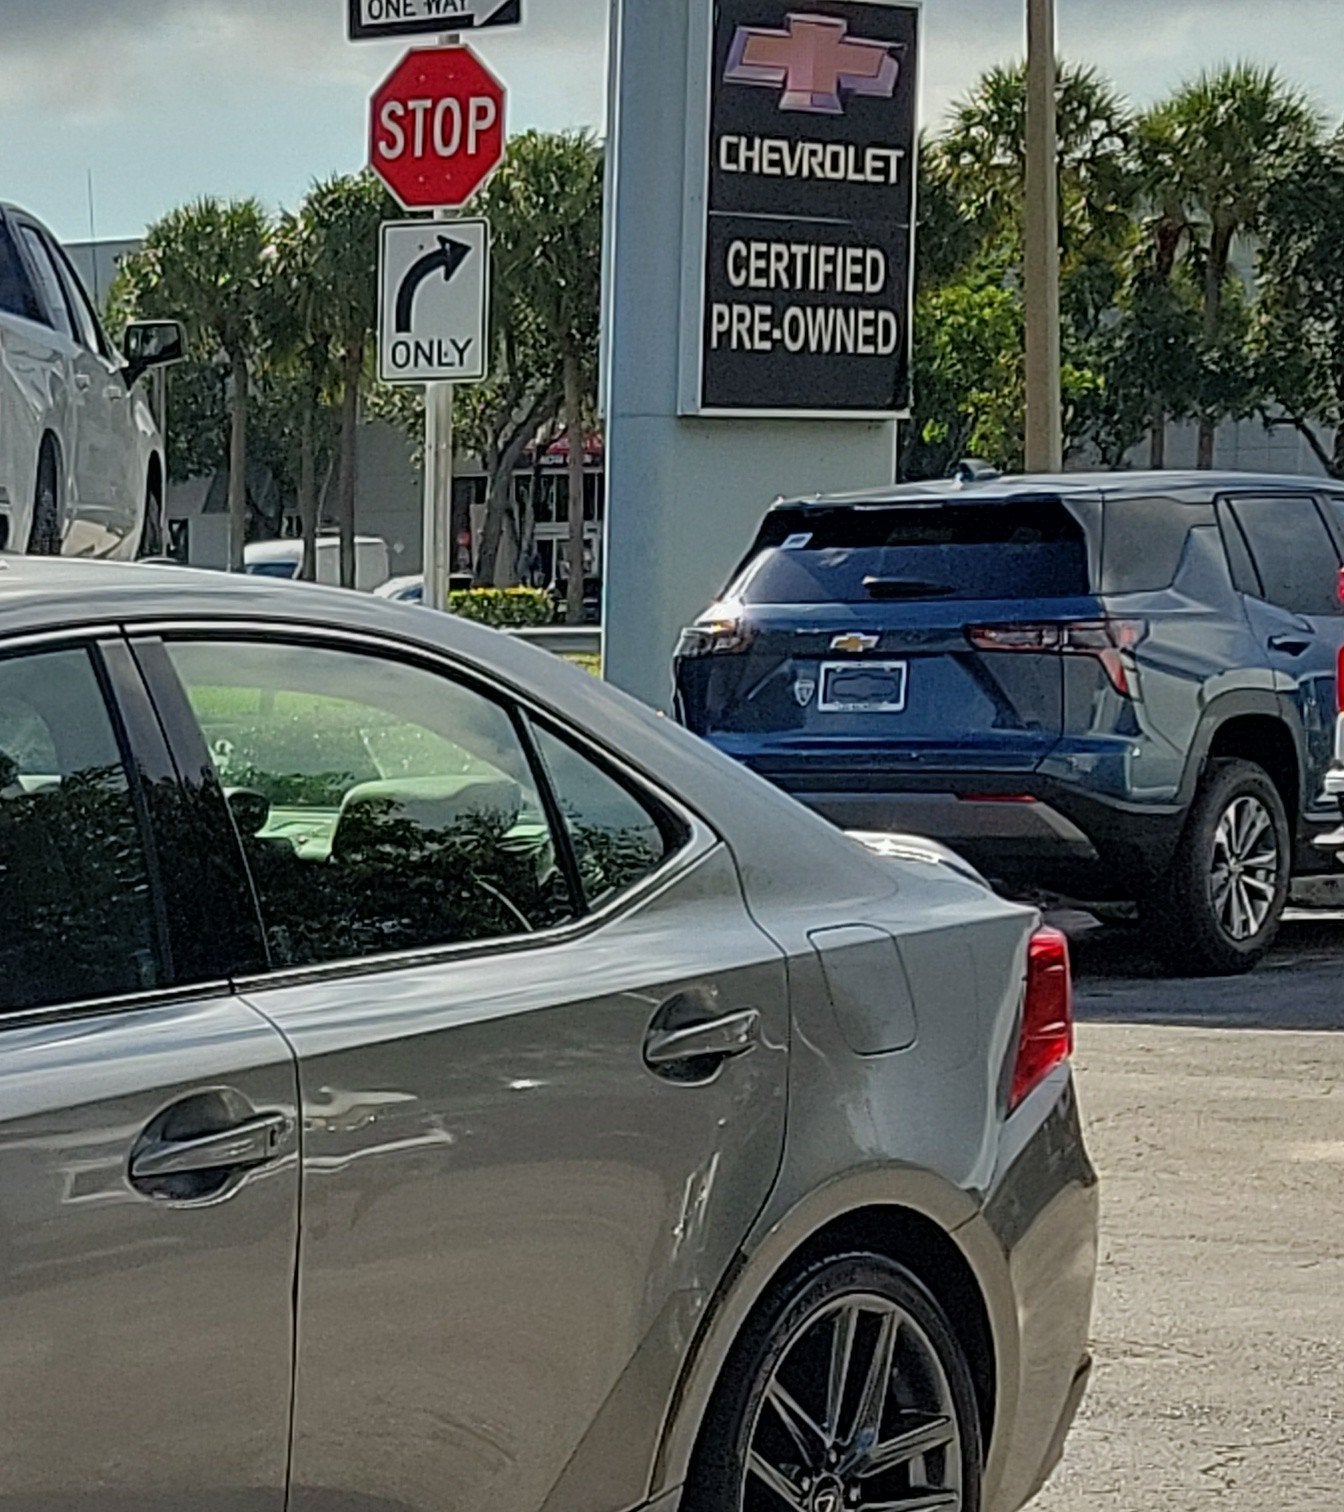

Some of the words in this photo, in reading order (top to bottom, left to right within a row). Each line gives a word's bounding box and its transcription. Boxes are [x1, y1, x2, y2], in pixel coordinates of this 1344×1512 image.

[368, 0, 416, 20] ONE
[378, 96, 497, 160] STOP
[719, 135, 905, 184] CHEVROLET
[727, 240, 886, 293] CERTIFIED
[391, 338, 473, 369] ONLY
[711, 303, 897, 355] PRE-OWNED
